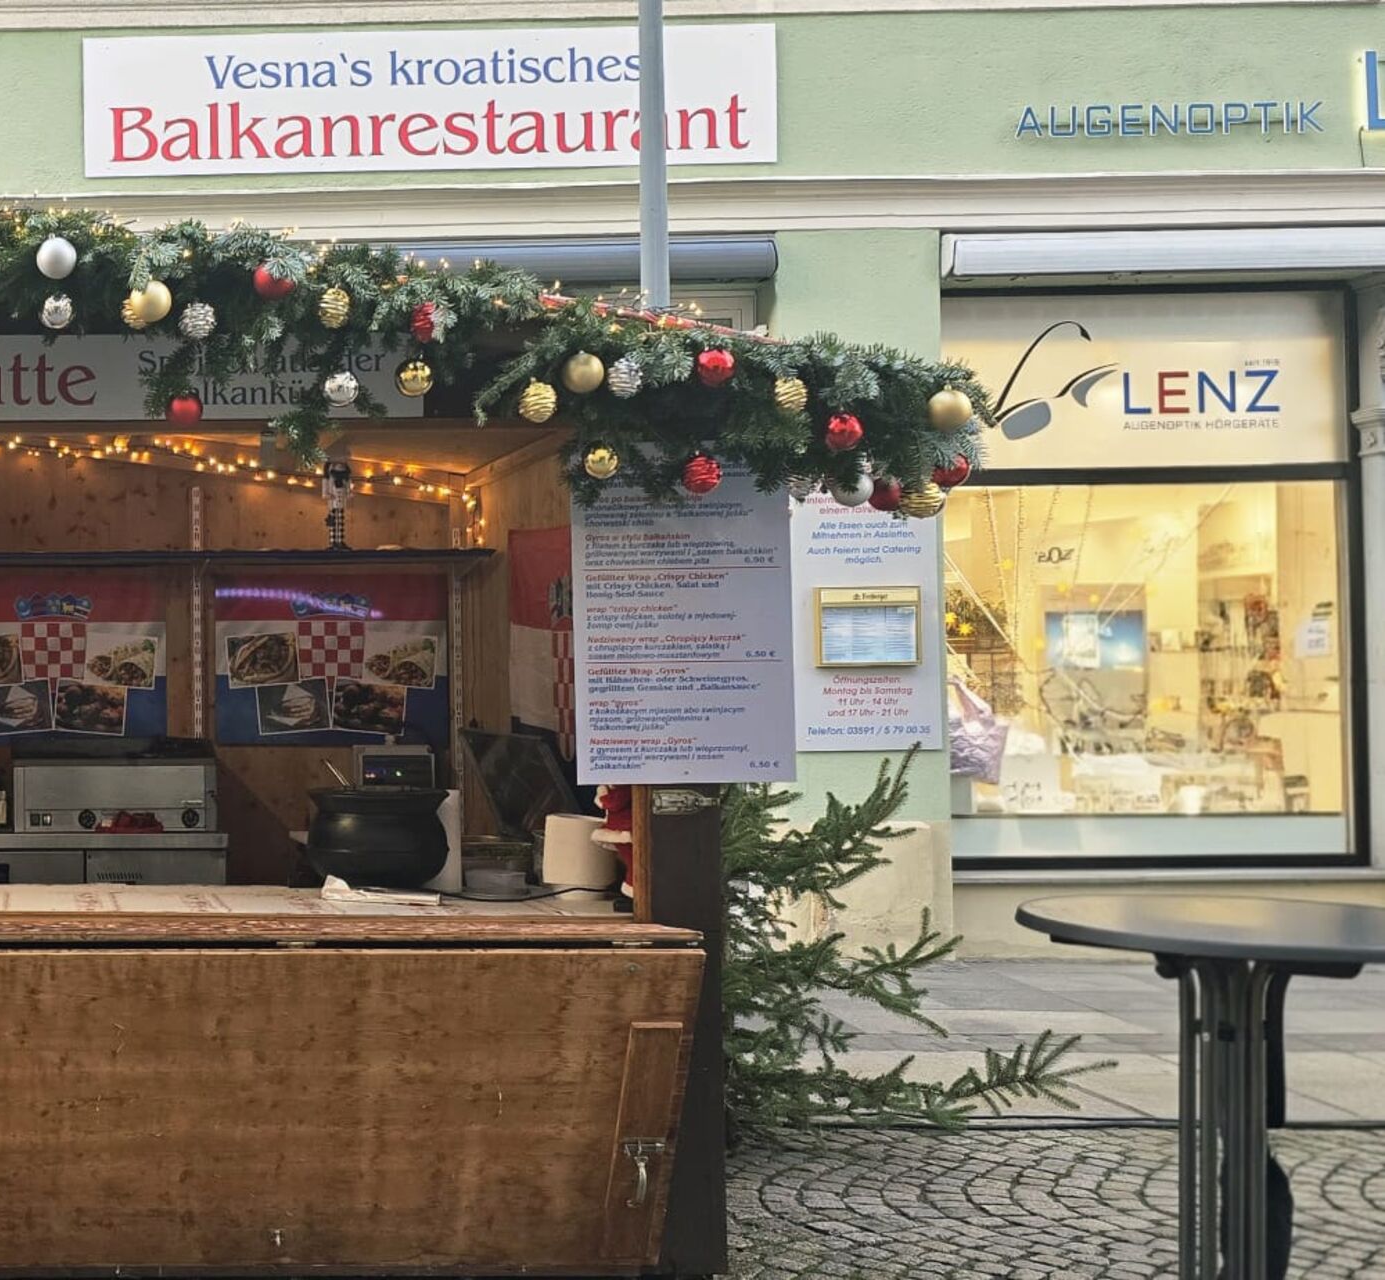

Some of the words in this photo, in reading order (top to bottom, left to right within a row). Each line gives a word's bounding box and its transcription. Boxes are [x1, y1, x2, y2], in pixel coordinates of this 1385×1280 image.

[389, 47, 643, 87] kroatisches
[1015, 101, 1325, 138] AUGENOPTIK
[1123, 370, 1281, 414] LENZ
[1123, 420, 1201, 430] AUGENOPTIK
[1205, 418, 1279, 429] HÖRGERÄTE
[807, 546, 831, 555] Auch
[862, 546, 880, 554] und
[882, 545, 922, 555] Catering
[822, 686, 858, 696] Montag
[860, 687, 873, 696] bis
[874, 687, 913, 697] Samstag
[848, 697, 865, 706] Uhr
[883, 697, 899, 705] Uhr
[827, 708, 846, 717] und
[858, 708, 875, 716] Uhr
[894, 708, 909, 716] Uhr
[807, 726, 845, 736] Telefon:
